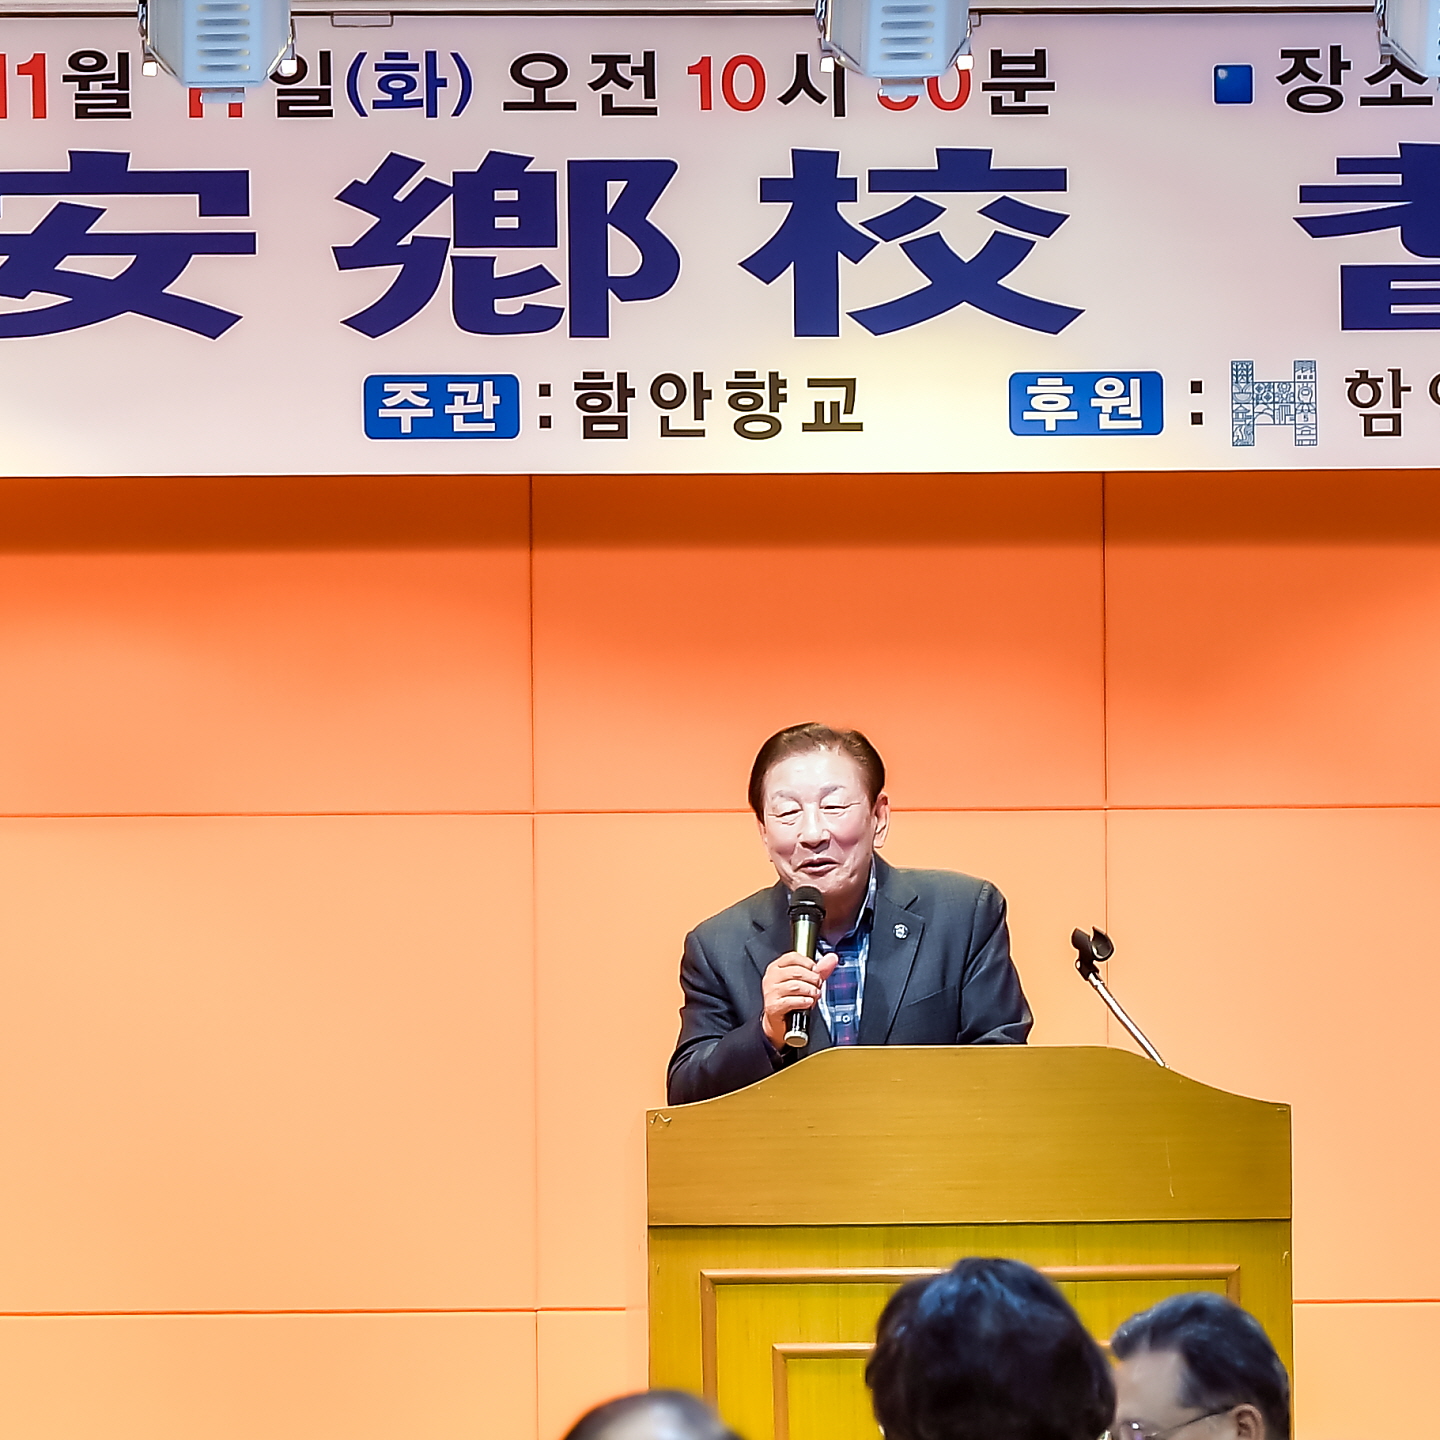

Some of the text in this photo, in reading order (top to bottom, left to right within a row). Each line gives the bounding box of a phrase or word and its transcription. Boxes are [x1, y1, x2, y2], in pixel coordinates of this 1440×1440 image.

[188, 49, 473, 119] 일(화)
[501, 50, 659, 118] 오전
[686, 53, 847, 118] 10시
[377, 377, 502, 435] 주관
[572, 368, 866, 441] 함안향교
[1021, 374, 1144, 433] 후원
